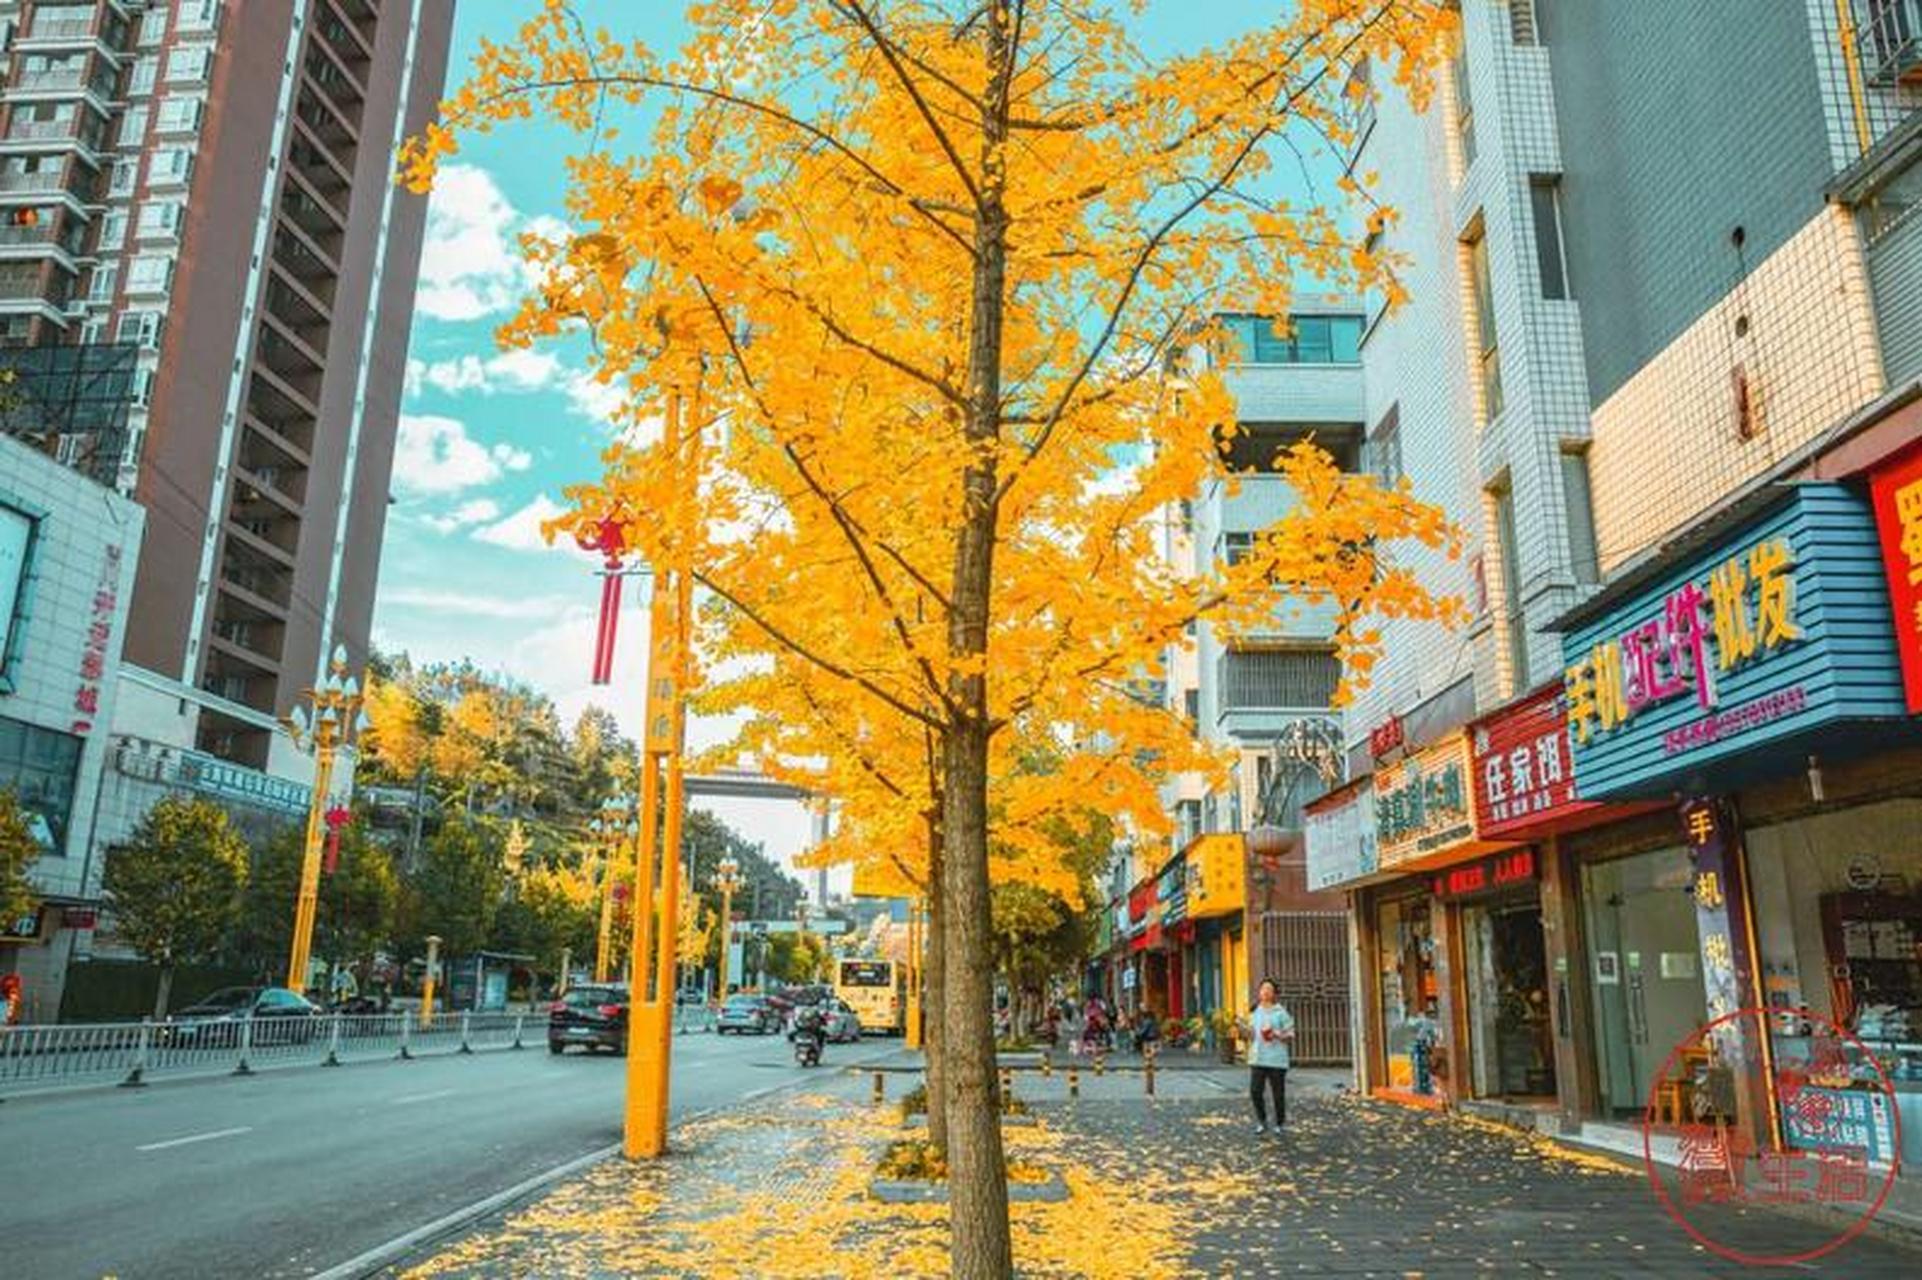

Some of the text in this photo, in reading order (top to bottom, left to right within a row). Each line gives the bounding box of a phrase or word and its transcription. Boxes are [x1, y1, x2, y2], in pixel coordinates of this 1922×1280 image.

[1565, 535, 1804, 745] 手机配件批发
